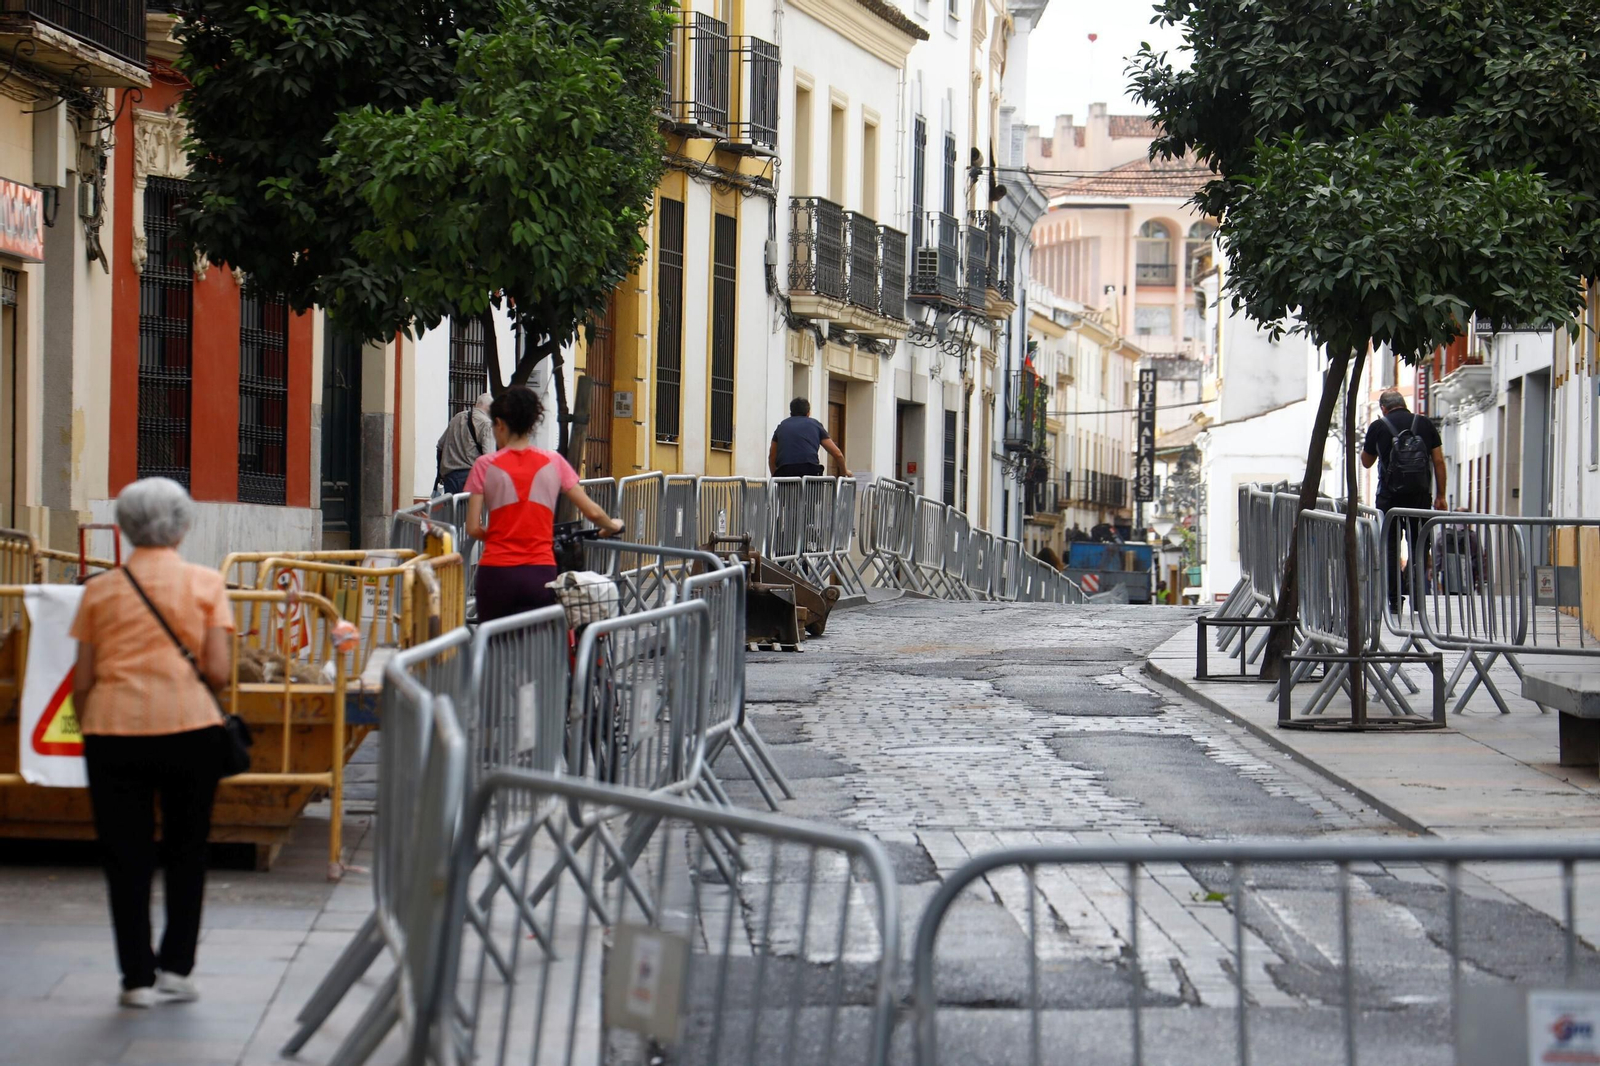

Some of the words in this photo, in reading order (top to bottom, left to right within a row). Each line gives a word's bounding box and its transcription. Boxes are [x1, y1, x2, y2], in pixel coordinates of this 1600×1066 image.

[1476, 322, 1507, 330] DIBO
[1141, 372, 1153, 423] HOTEL
[1139, 427, 1151, 497] ALFAROS
